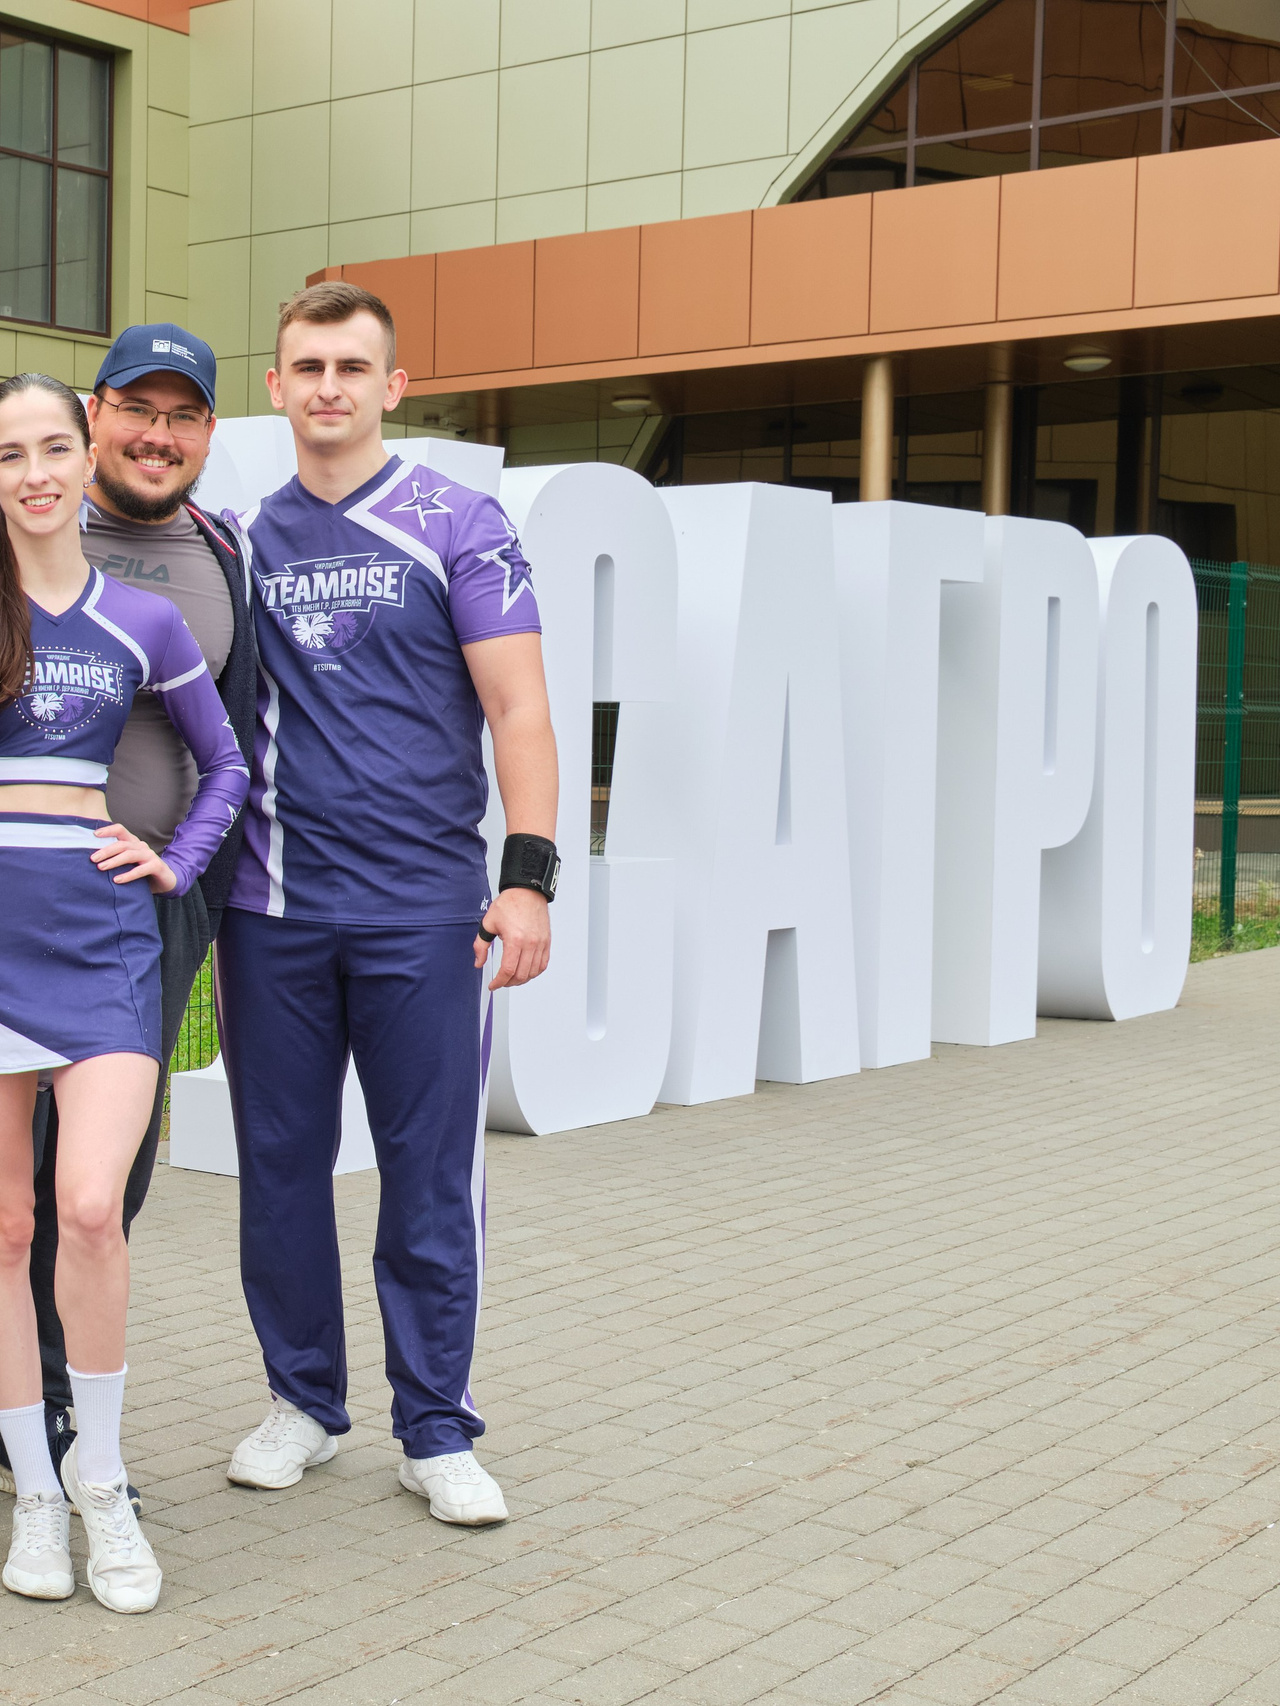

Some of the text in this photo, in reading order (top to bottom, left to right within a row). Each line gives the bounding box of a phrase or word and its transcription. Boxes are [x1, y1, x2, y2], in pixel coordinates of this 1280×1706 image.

[101, 554, 170, 583] FILA
[263, 565, 400, 607] TEAMRISE
[291, 598, 362, 613] ТГУ ИМЕНИ Г.Р. ДЕРЖАВИНА
